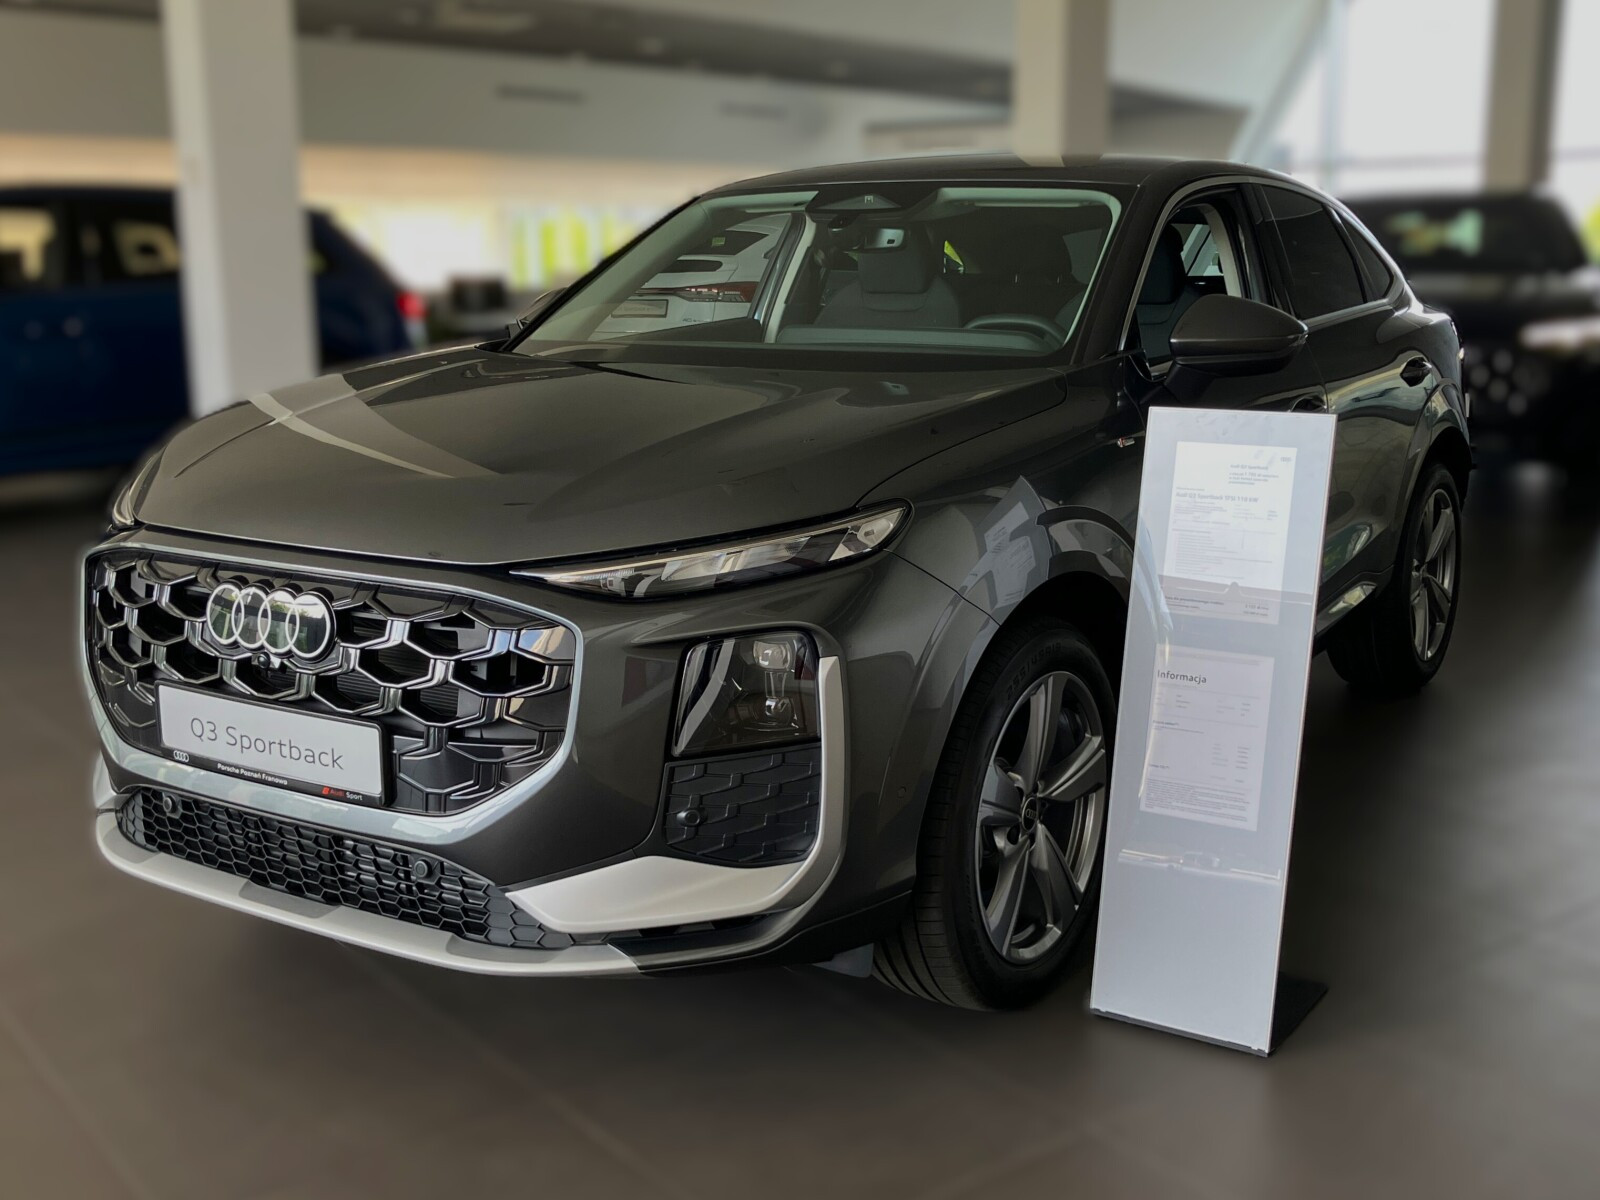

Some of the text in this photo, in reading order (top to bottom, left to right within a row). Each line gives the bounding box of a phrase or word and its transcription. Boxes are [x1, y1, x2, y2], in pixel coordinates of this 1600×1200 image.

[1157, 669, 1207, 685] Informacja
[190, 717, 344, 770] Q3 Sportback
[217, 763, 239, 774] Porsche
[240, 768, 261, 778] Poznań
[330, 788, 363, 801] Audi Sport
